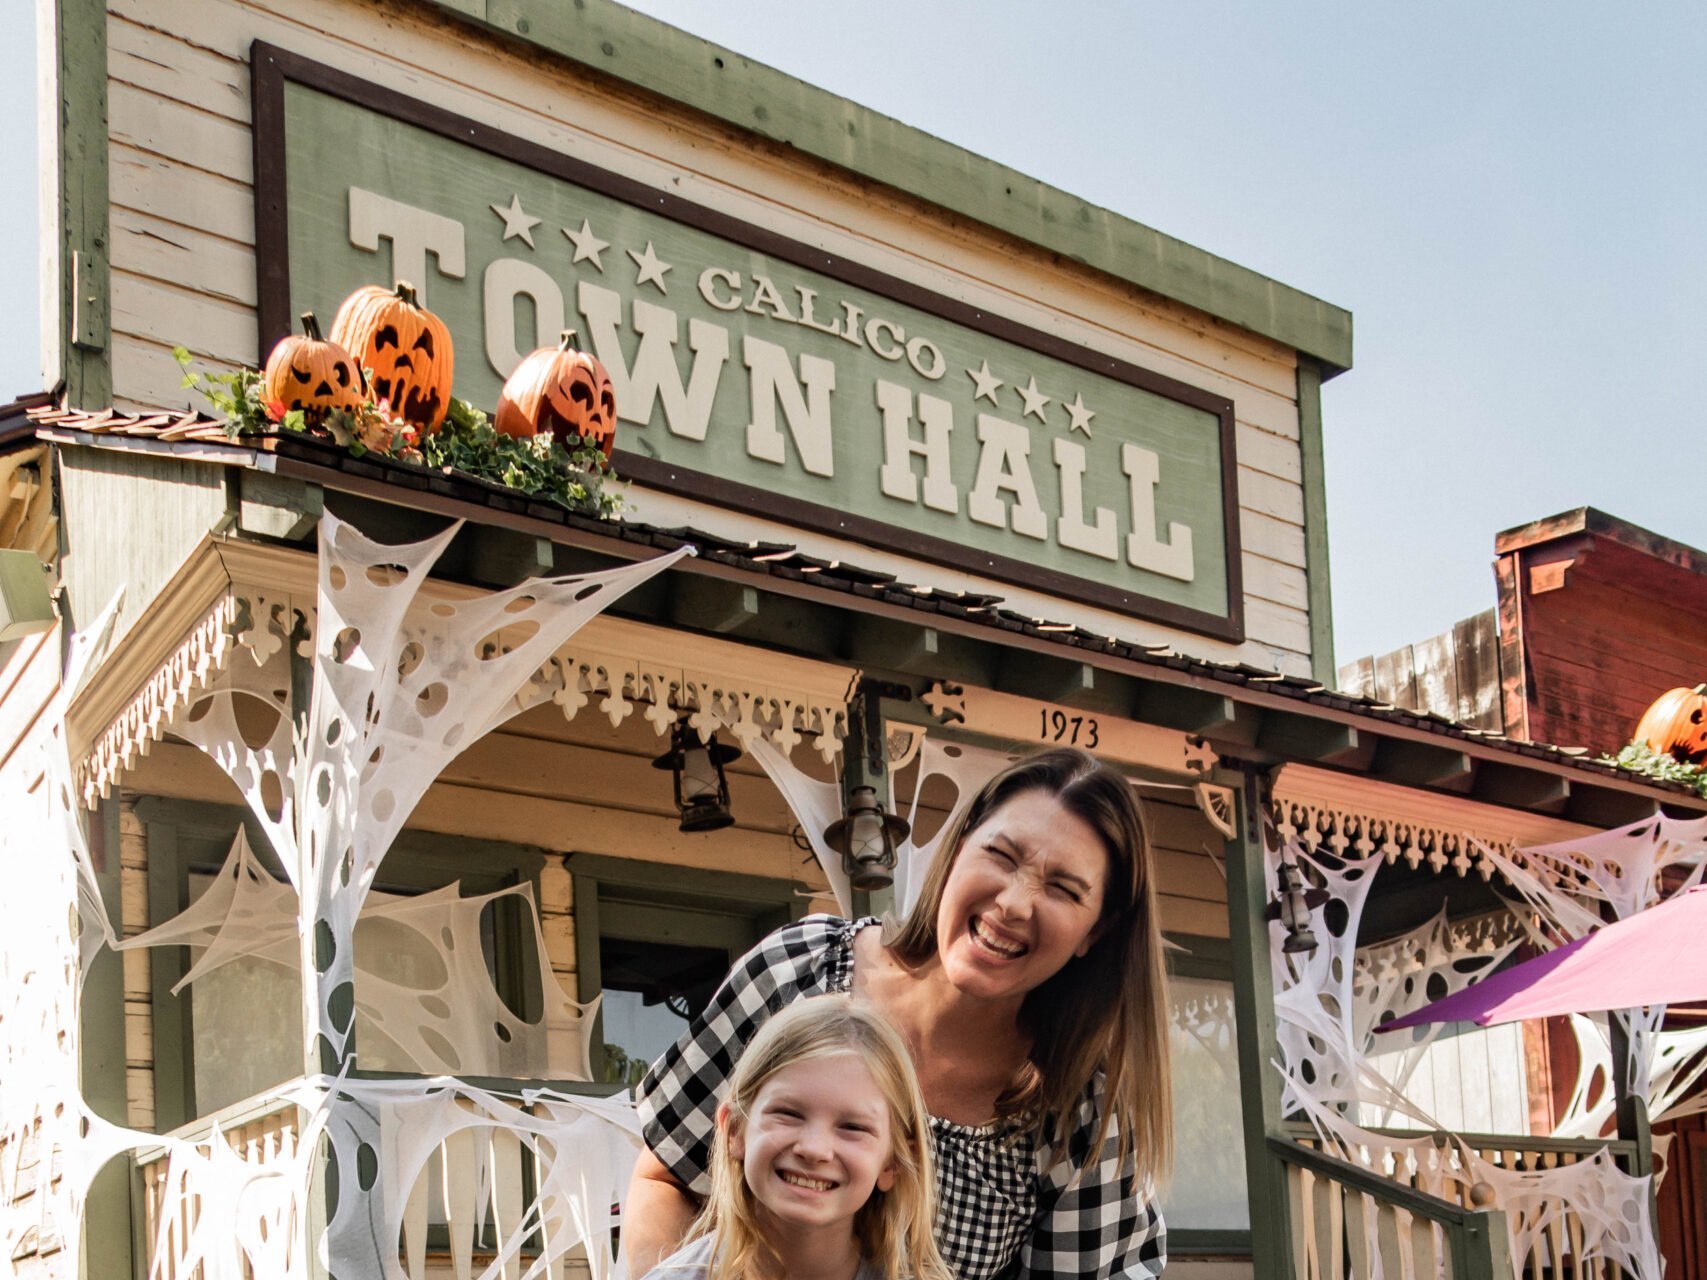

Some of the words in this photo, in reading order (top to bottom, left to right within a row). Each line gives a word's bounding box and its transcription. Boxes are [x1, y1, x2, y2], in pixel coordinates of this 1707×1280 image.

[698, 267, 946, 380] CALICO
[348, 186, 836, 478] TOWN
[875, 378, 1194, 583] HALL
[1041, 708, 1099, 749] 1973
